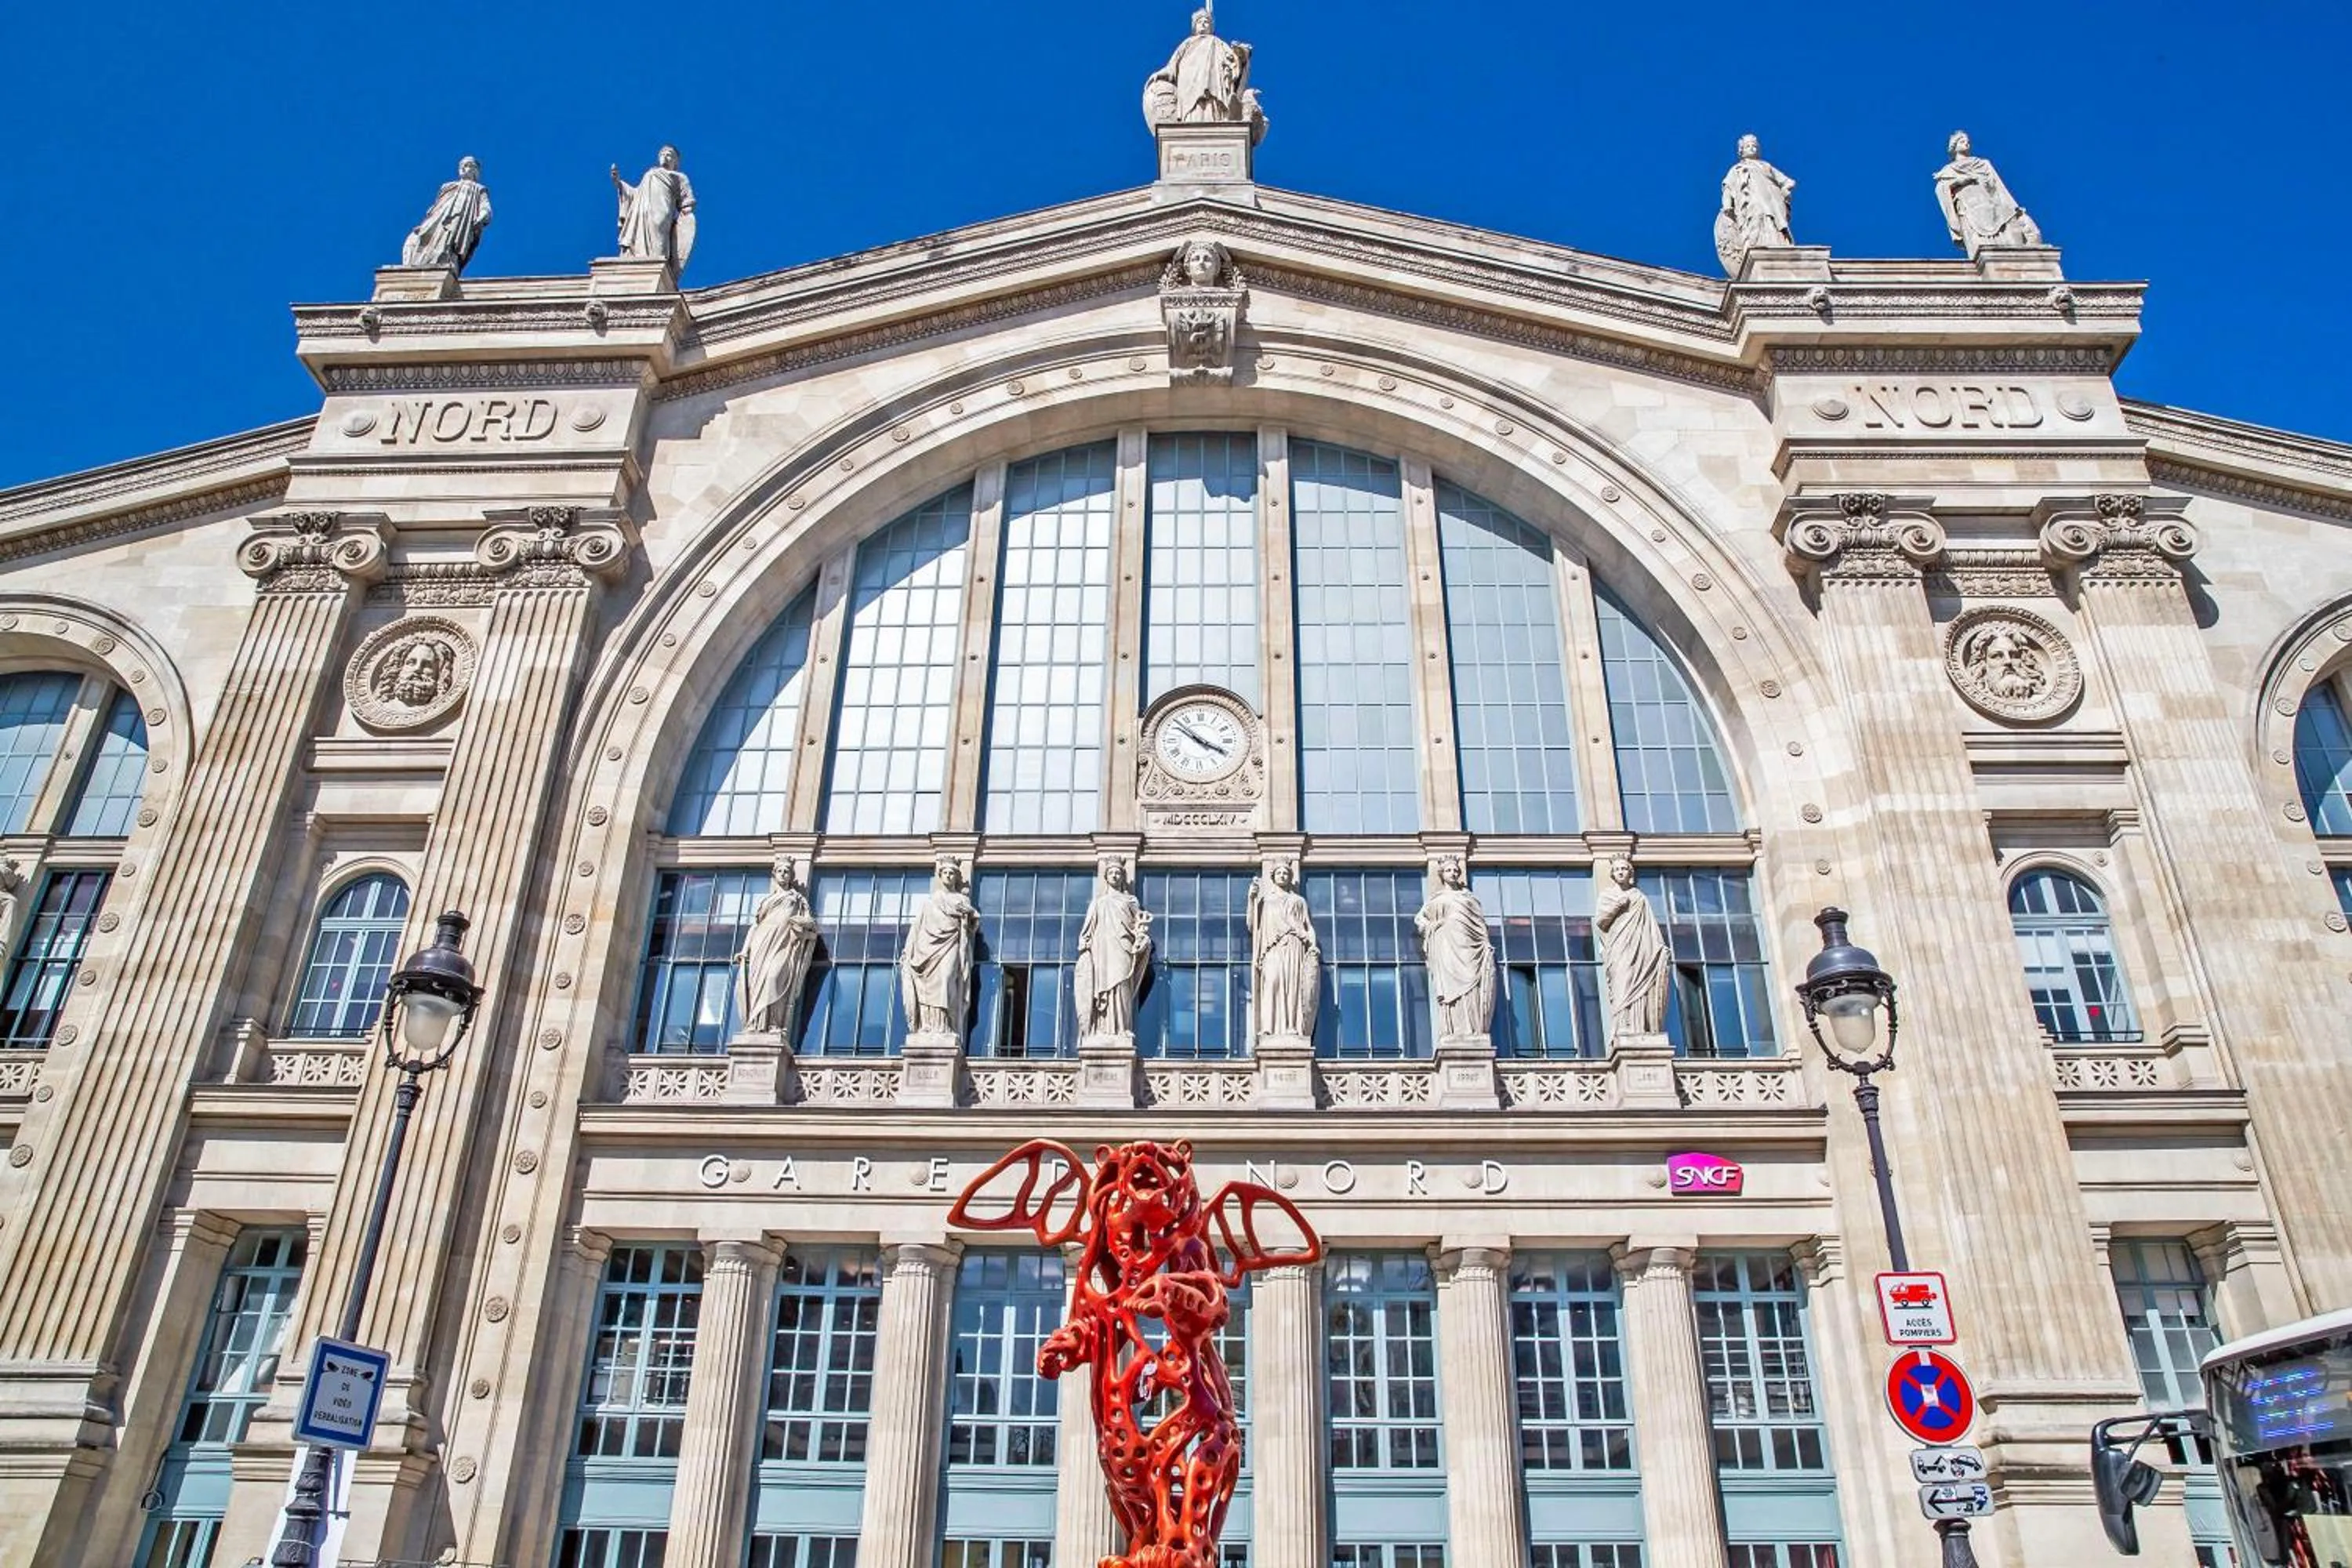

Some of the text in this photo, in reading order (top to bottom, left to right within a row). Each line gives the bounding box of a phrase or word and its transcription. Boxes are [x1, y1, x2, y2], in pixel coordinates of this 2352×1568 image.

[1173, 152, 1231, 167] PARIS
[1854, 386, 2044, 428] NORD
[380, 399, 559, 445] NORD
[699, 1153, 949, 1191] GARE
[1247, 1160, 1508, 1195] NORD
[1674, 1166, 1740, 1187] SNCF
[341, 1365, 359, 1377] ZONE
[341, 1382, 350, 1392] DE
[314, 1410, 363, 1427] VERBALISATION
